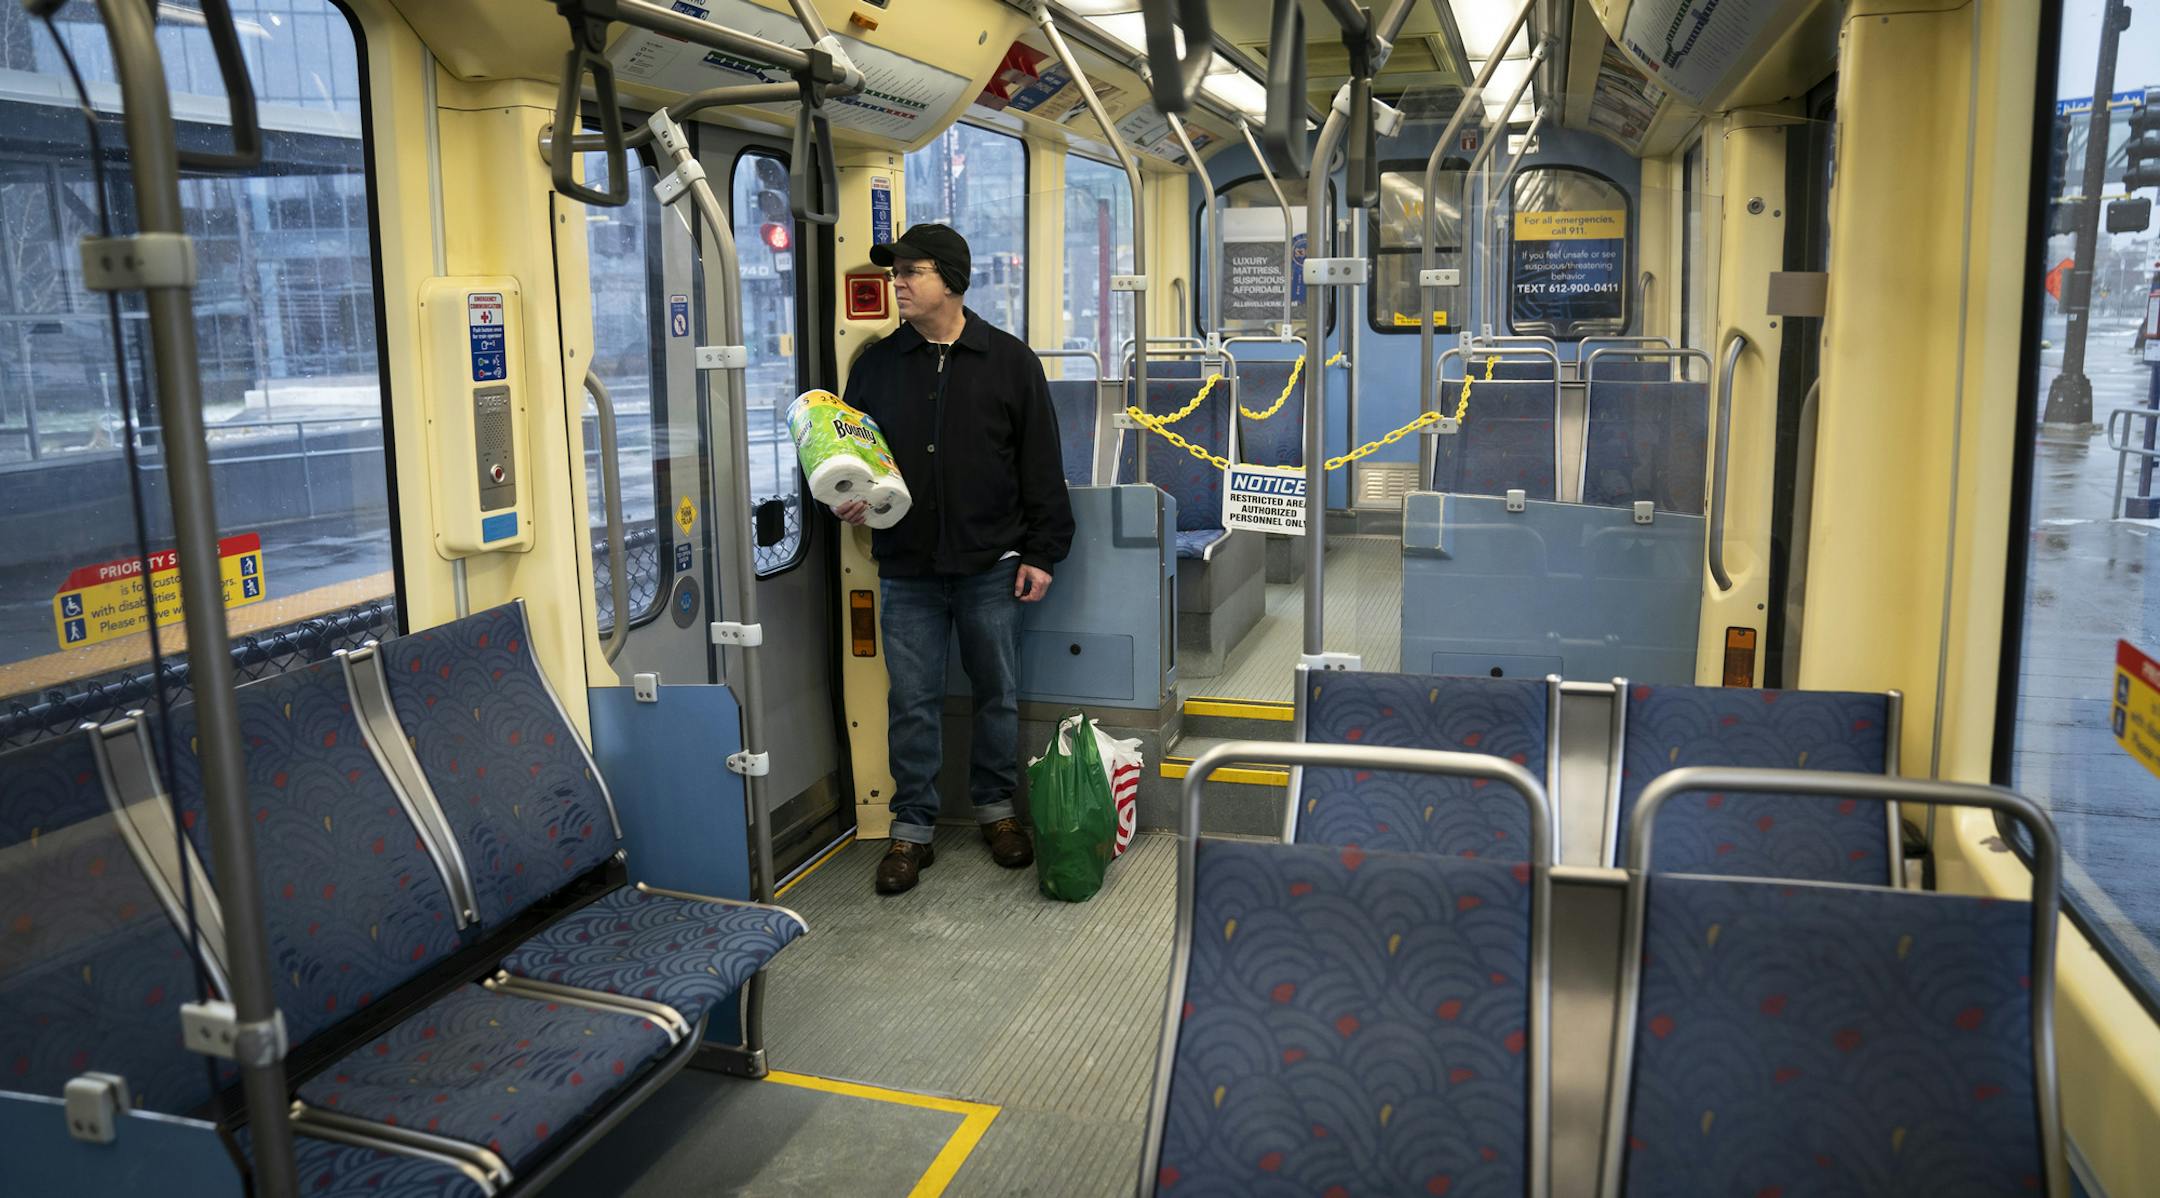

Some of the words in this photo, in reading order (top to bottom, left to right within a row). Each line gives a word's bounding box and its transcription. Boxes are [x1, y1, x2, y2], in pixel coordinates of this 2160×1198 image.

[1524, 217, 1539, 225] For
[1542, 216, 1553, 224] all
[1555, 216, 1616, 225] emergencies,
[1552, 227, 1567, 235] call
[1232, 257, 1268, 265] LUXURY
[1522, 251, 1528, 259] If
[1528, 252, 1544, 261] you
[1546, 251, 1561, 259] feel
[1563, 250, 1589, 258] unsafe
[1524, 261, 1613, 272] suspicious/threatening
[1232, 276, 1286, 285] SUSPICIOUS
[1551, 272, 1587, 280] behavior
[1232, 286, 1286, 294] AFFORDABL
[1517, 284, 1546, 293] TEXT
[1549, 283, 1619, 293] 612-900-0411
[833, 419, 877, 444] Bounty
[1233, 474, 1306, 495] NOTICE
[1230, 493, 1284, 506] RESTRICTED
[1286, 499, 1307, 508] ARE
[1241, 505, 1297, 517] AUTHORIZED
[1230, 513, 1284, 526] PERSONNEL
[99, 555, 164, 579] PRIORTY
[120, 585, 129, 595] is
[91, 604, 116, 619] with
[119, 591, 177, 612] disabities
[100, 618, 135, 632] Please
